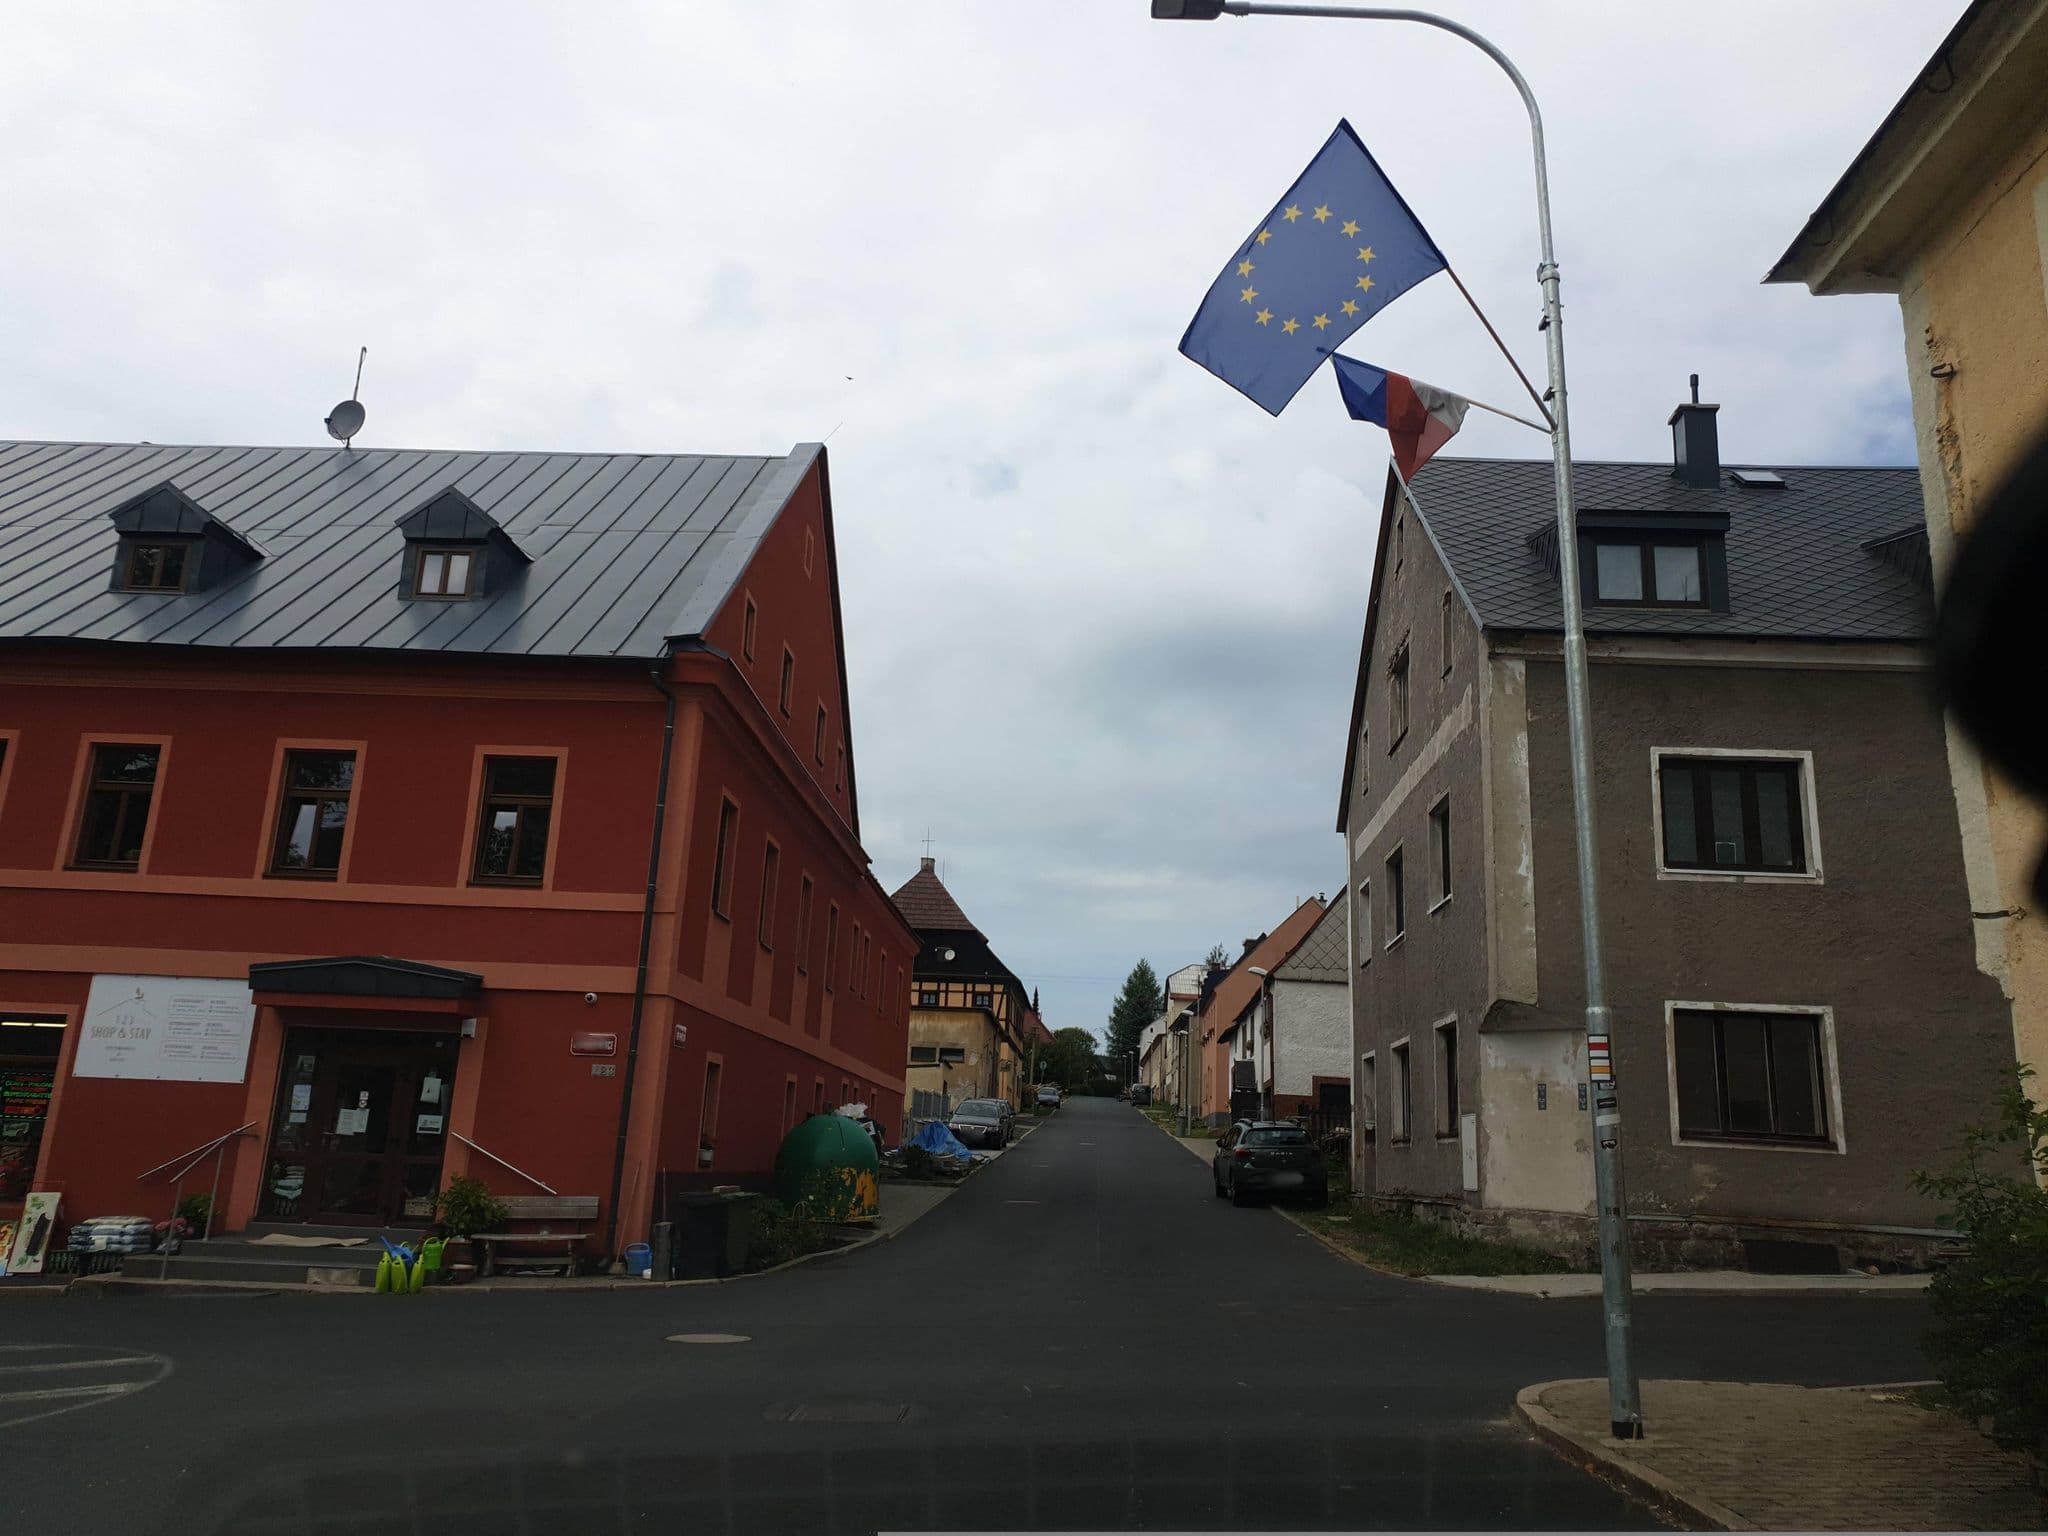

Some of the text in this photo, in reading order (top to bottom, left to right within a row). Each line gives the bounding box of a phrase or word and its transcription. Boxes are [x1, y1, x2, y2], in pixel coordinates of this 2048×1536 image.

[90, 1026, 152, 1040] SHOP & STAY
